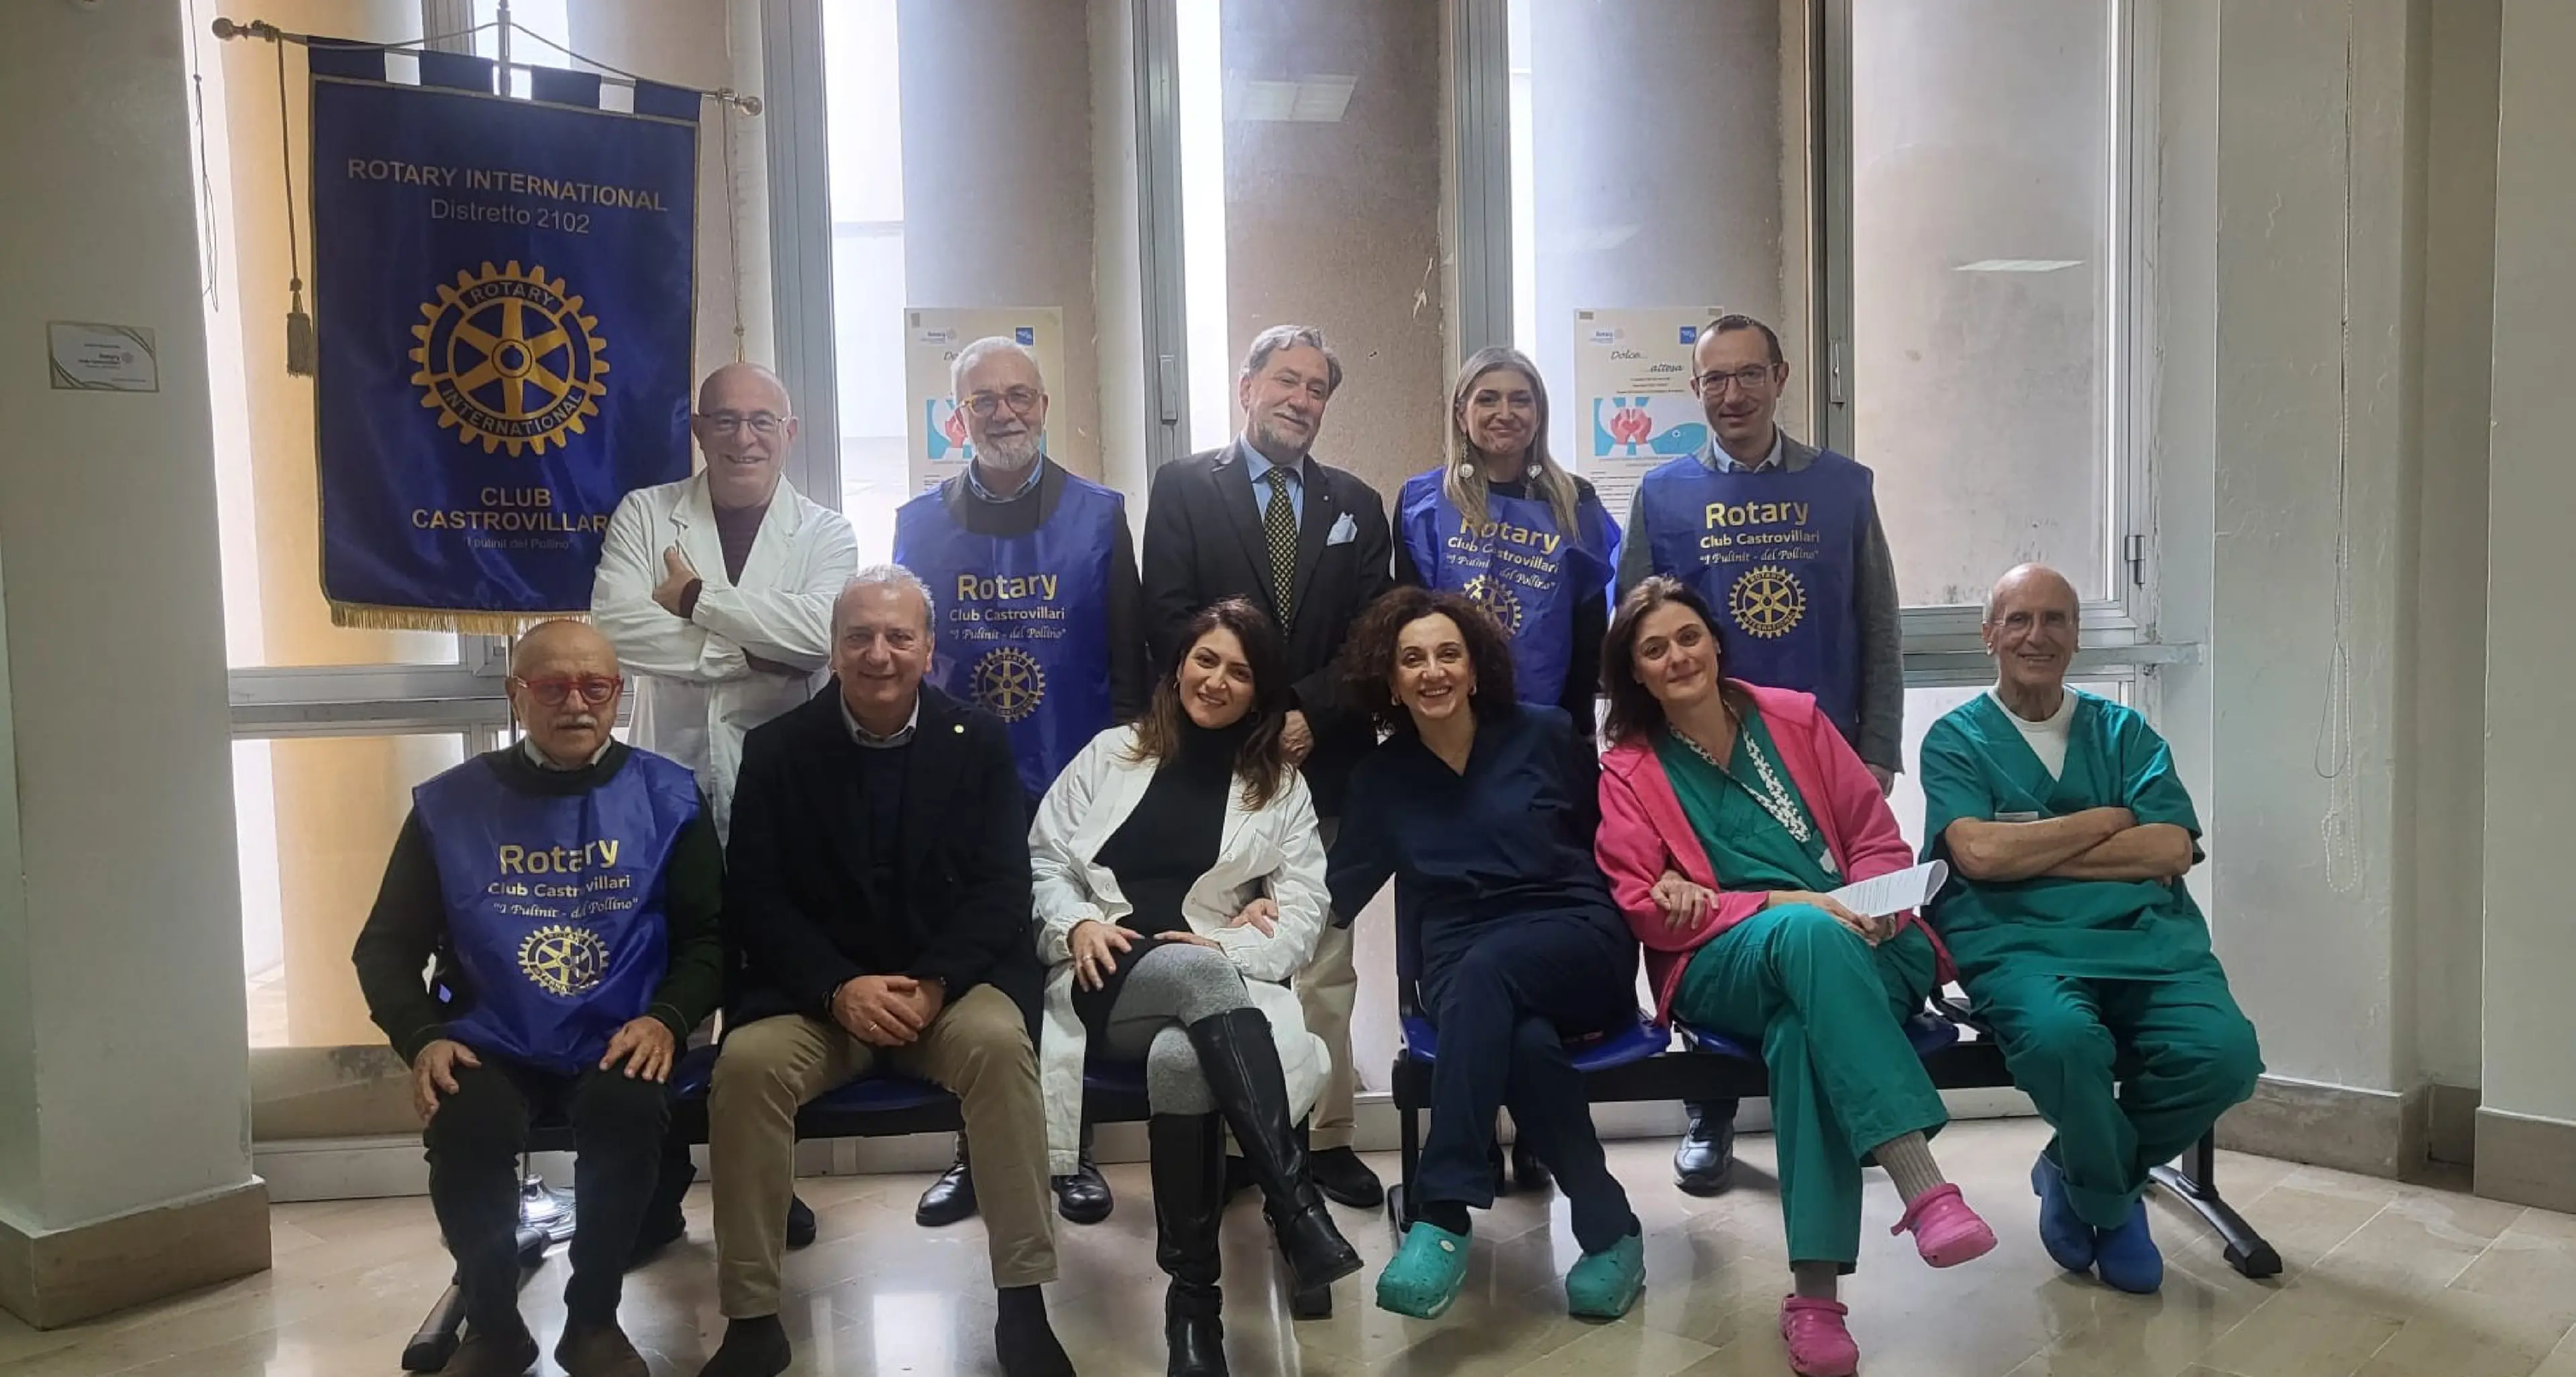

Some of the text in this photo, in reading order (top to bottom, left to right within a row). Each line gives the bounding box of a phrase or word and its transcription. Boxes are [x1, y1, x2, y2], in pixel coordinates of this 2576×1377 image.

[347, 158, 669, 213] ROTARY INTERNATIONAL
[431, 199, 590, 235] Distretto 2102
[470, 280, 554, 307] ROTARY
[442, 386, 584, 437] INTERNATIONAL
[480, 487, 551, 508] CLUB
[411, 510, 608, 534] CASTROVILLAR
[1706, 501, 1809, 529] Rotary
[1447, 537, 1479, 553] Club
[1700, 529, 1819, 549] Club Castrovillari
[957, 574, 1057, 601] Rotary
[949, 606, 1065, 622] Club Castrovillari
[499, 839, 619, 875] Rotary
[488, 875, 631, 897] Club Castrvillari
